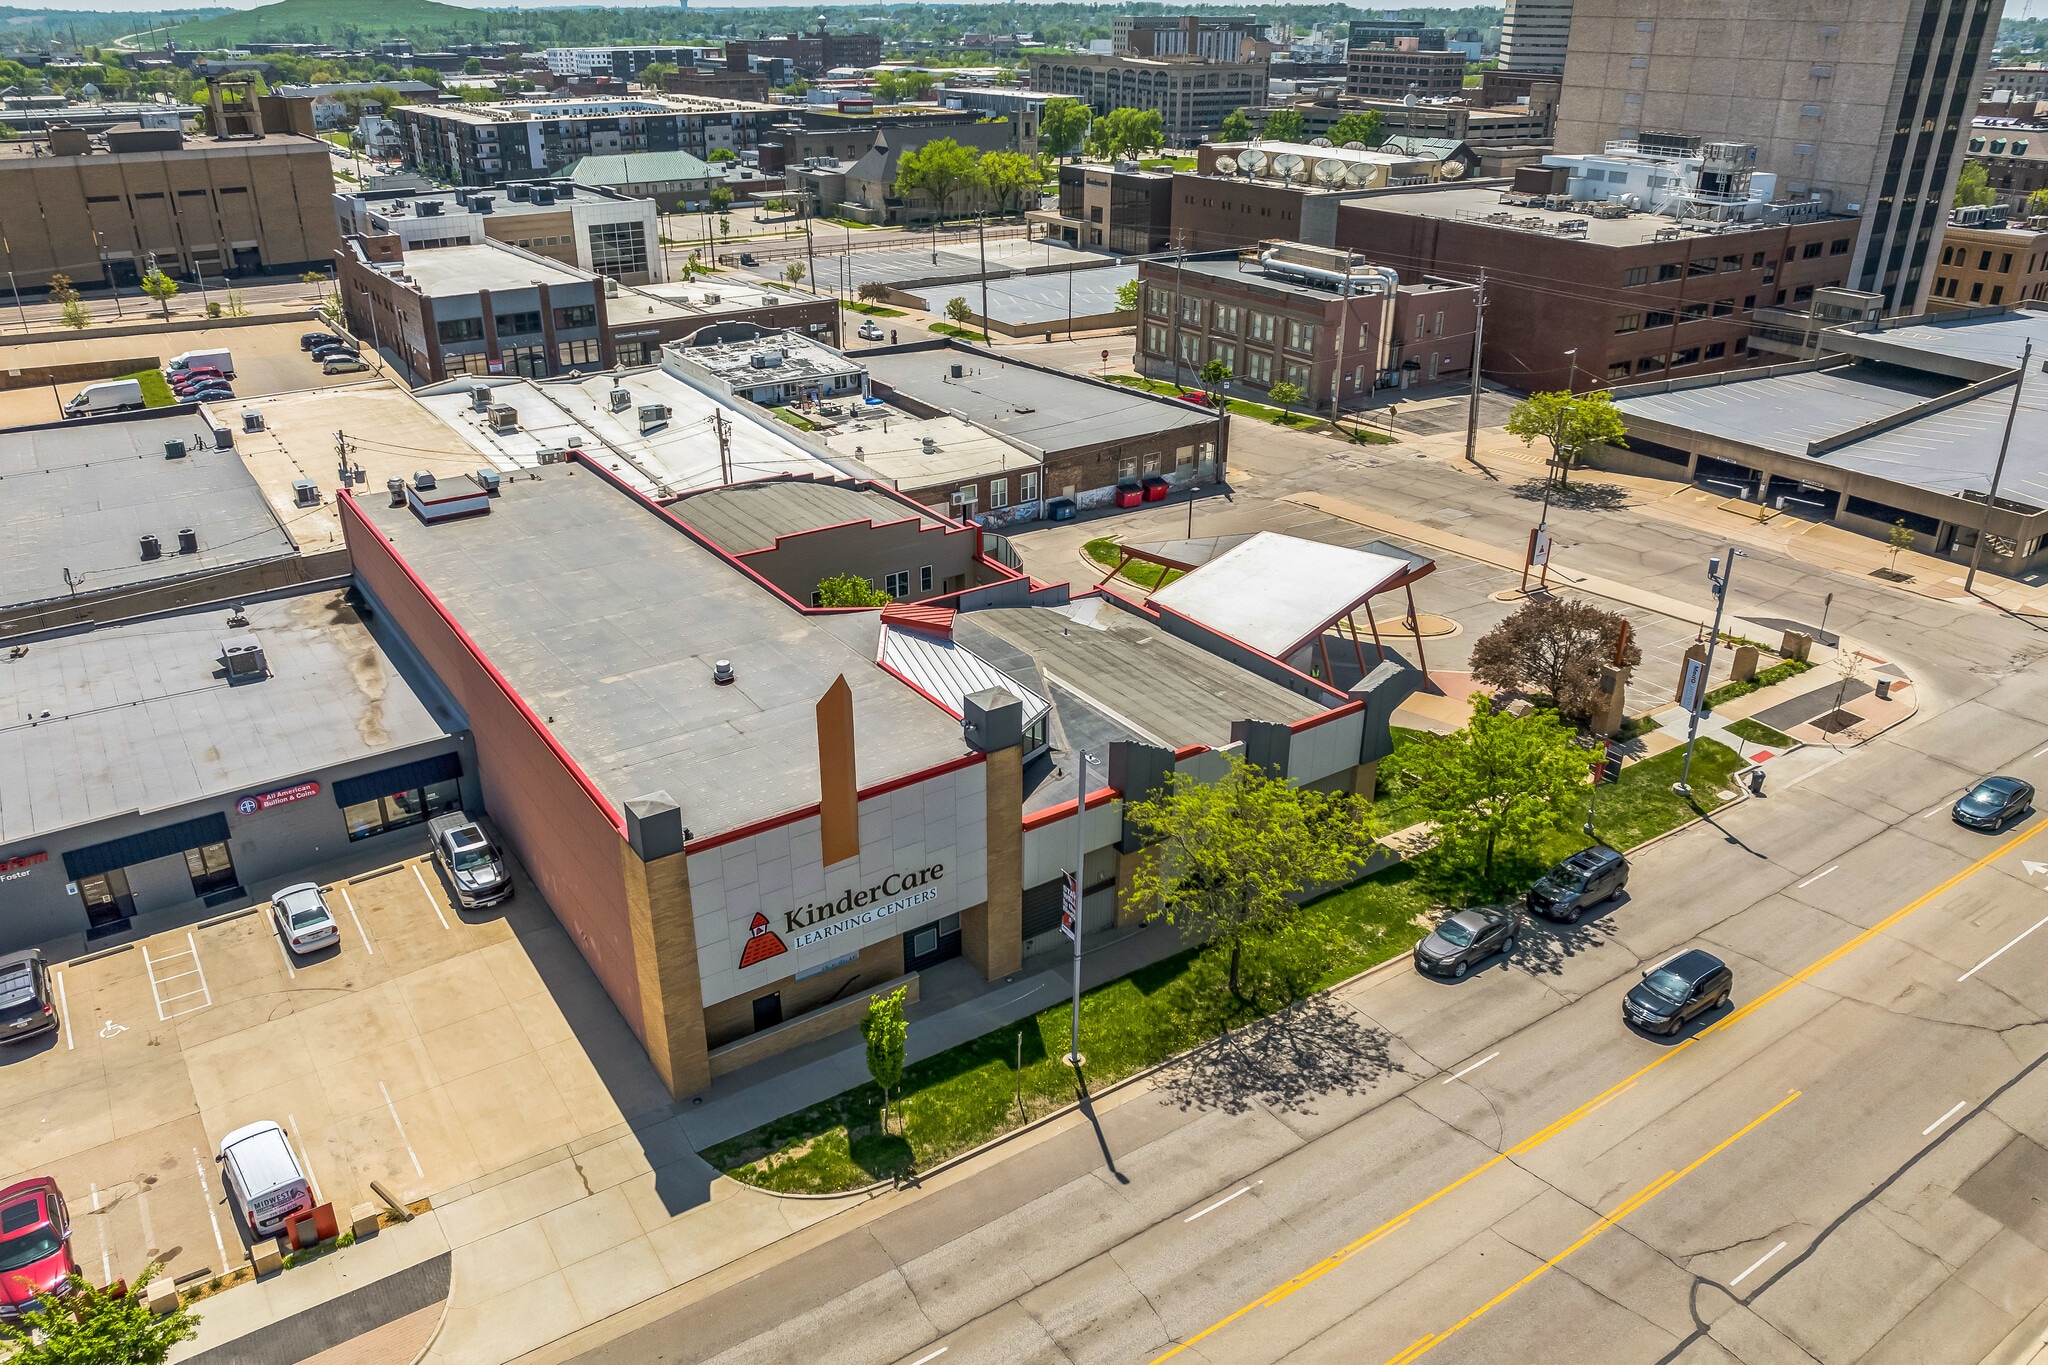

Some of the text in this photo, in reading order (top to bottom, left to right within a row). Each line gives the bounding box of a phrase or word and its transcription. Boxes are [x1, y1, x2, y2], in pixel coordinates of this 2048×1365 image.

[264, 797, 288, 808] Bullion
[296, 789, 316, 799] Coins
[277, 785, 311, 797] American
[0, 870, 31, 882] Foster
[784, 863, 944, 934] KinderCare
[796, 887, 936, 948] LEARNING CENTERS
[254, 1190, 290, 1210] MIDWEST
